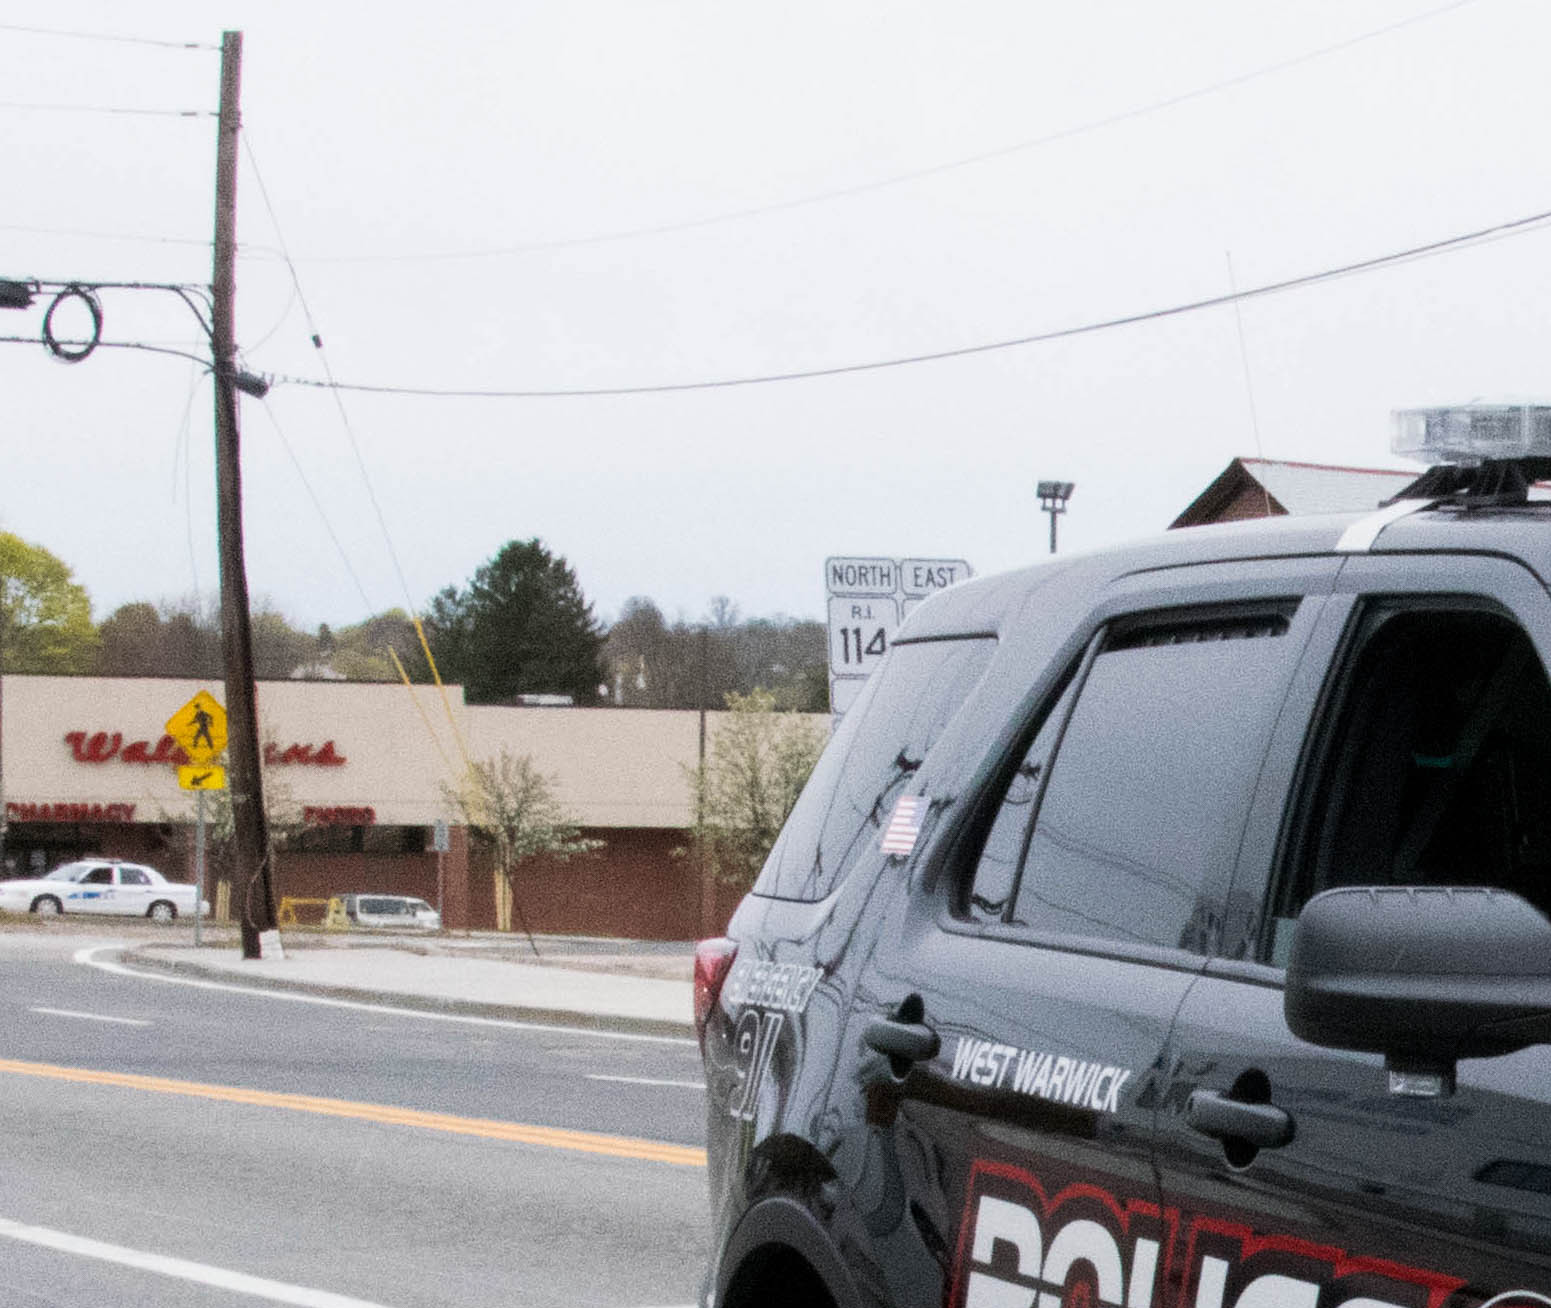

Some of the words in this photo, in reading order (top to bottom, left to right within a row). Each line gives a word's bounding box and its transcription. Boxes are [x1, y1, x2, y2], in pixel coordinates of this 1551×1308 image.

[832, 565, 891, 587] NORTH
[913, 567, 956, 588] EAST
[840, 627, 886, 664] 114
[952, 1037, 1018, 1088] WEST
[1013, 1049, 1130, 1113] WARWICK
